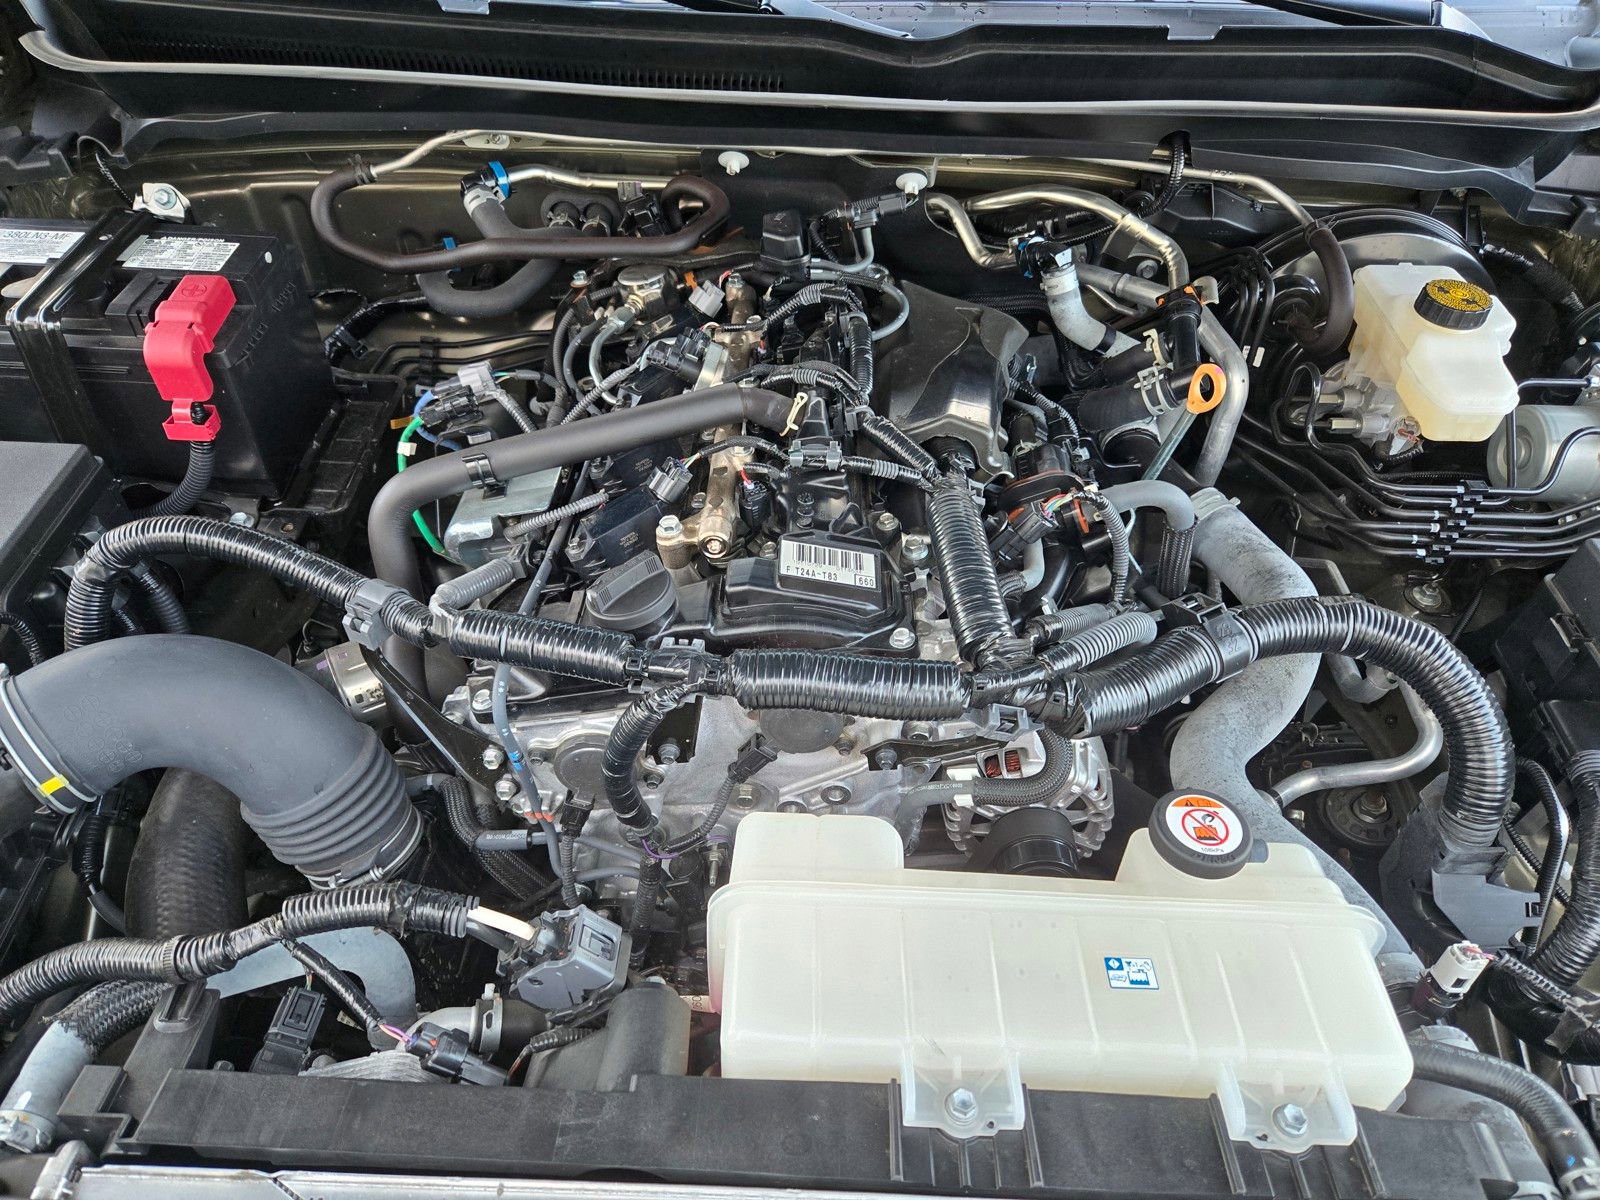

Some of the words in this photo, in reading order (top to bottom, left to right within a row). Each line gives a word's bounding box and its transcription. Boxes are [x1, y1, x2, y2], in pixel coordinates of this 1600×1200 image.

[786, 565, 791, 573] F
[795, 566, 838, 581] T24A-T83
[858, 577, 874, 587] 660
